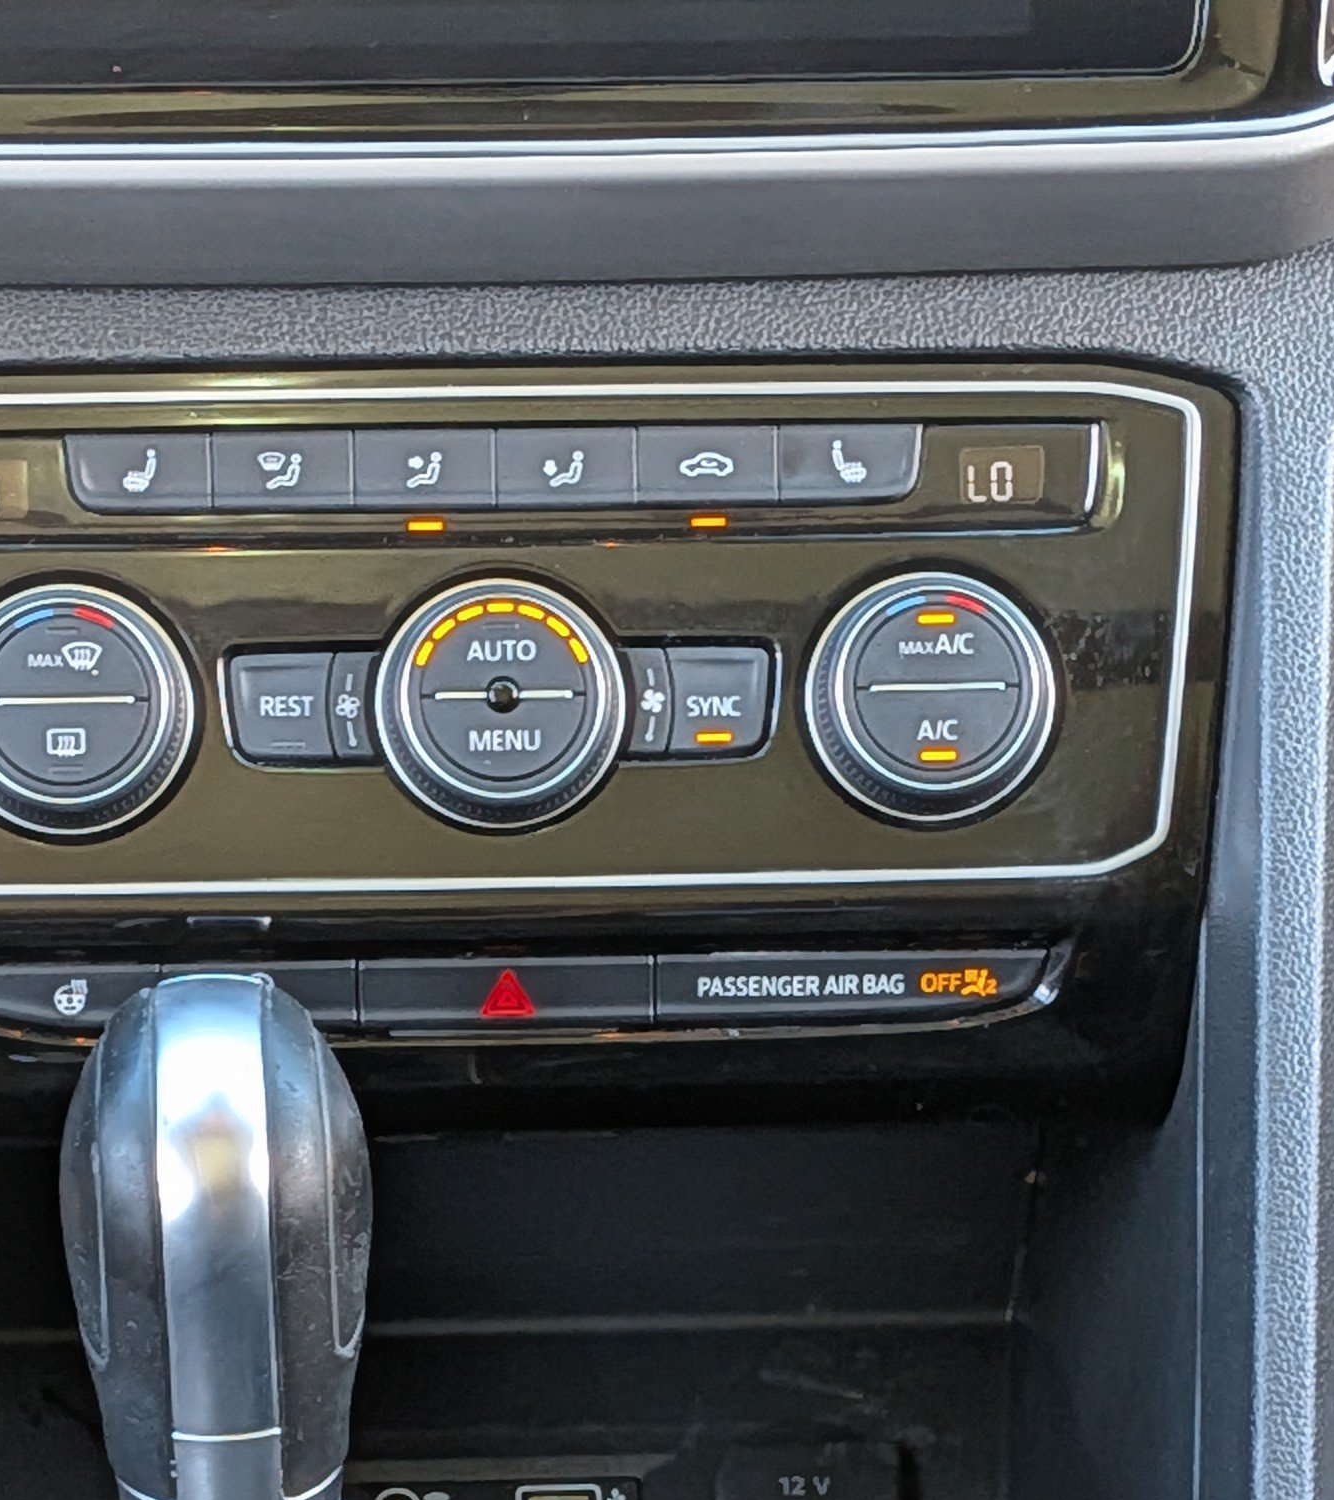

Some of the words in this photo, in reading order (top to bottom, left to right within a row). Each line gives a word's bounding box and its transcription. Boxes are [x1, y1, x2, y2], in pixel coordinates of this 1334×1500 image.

[965, 460, 1014, 504] LO
[27, 653, 64, 668] MAX
[466, 638, 537, 663] AUTO
[259, 695, 313, 718] REST
[685, 695, 742, 718] SYNC
[468, 728, 542, 753] MENU
[917, 718, 959, 742] A/C
[696, 974, 820, 998] PASSENGER
[822, 973, 860, 997] AIR
[862, 972, 906, 996] BAG
[919, 971, 962, 994] OFF
[778, 1474, 807, 1497] 12
[813, 1474, 832, 1497] V
